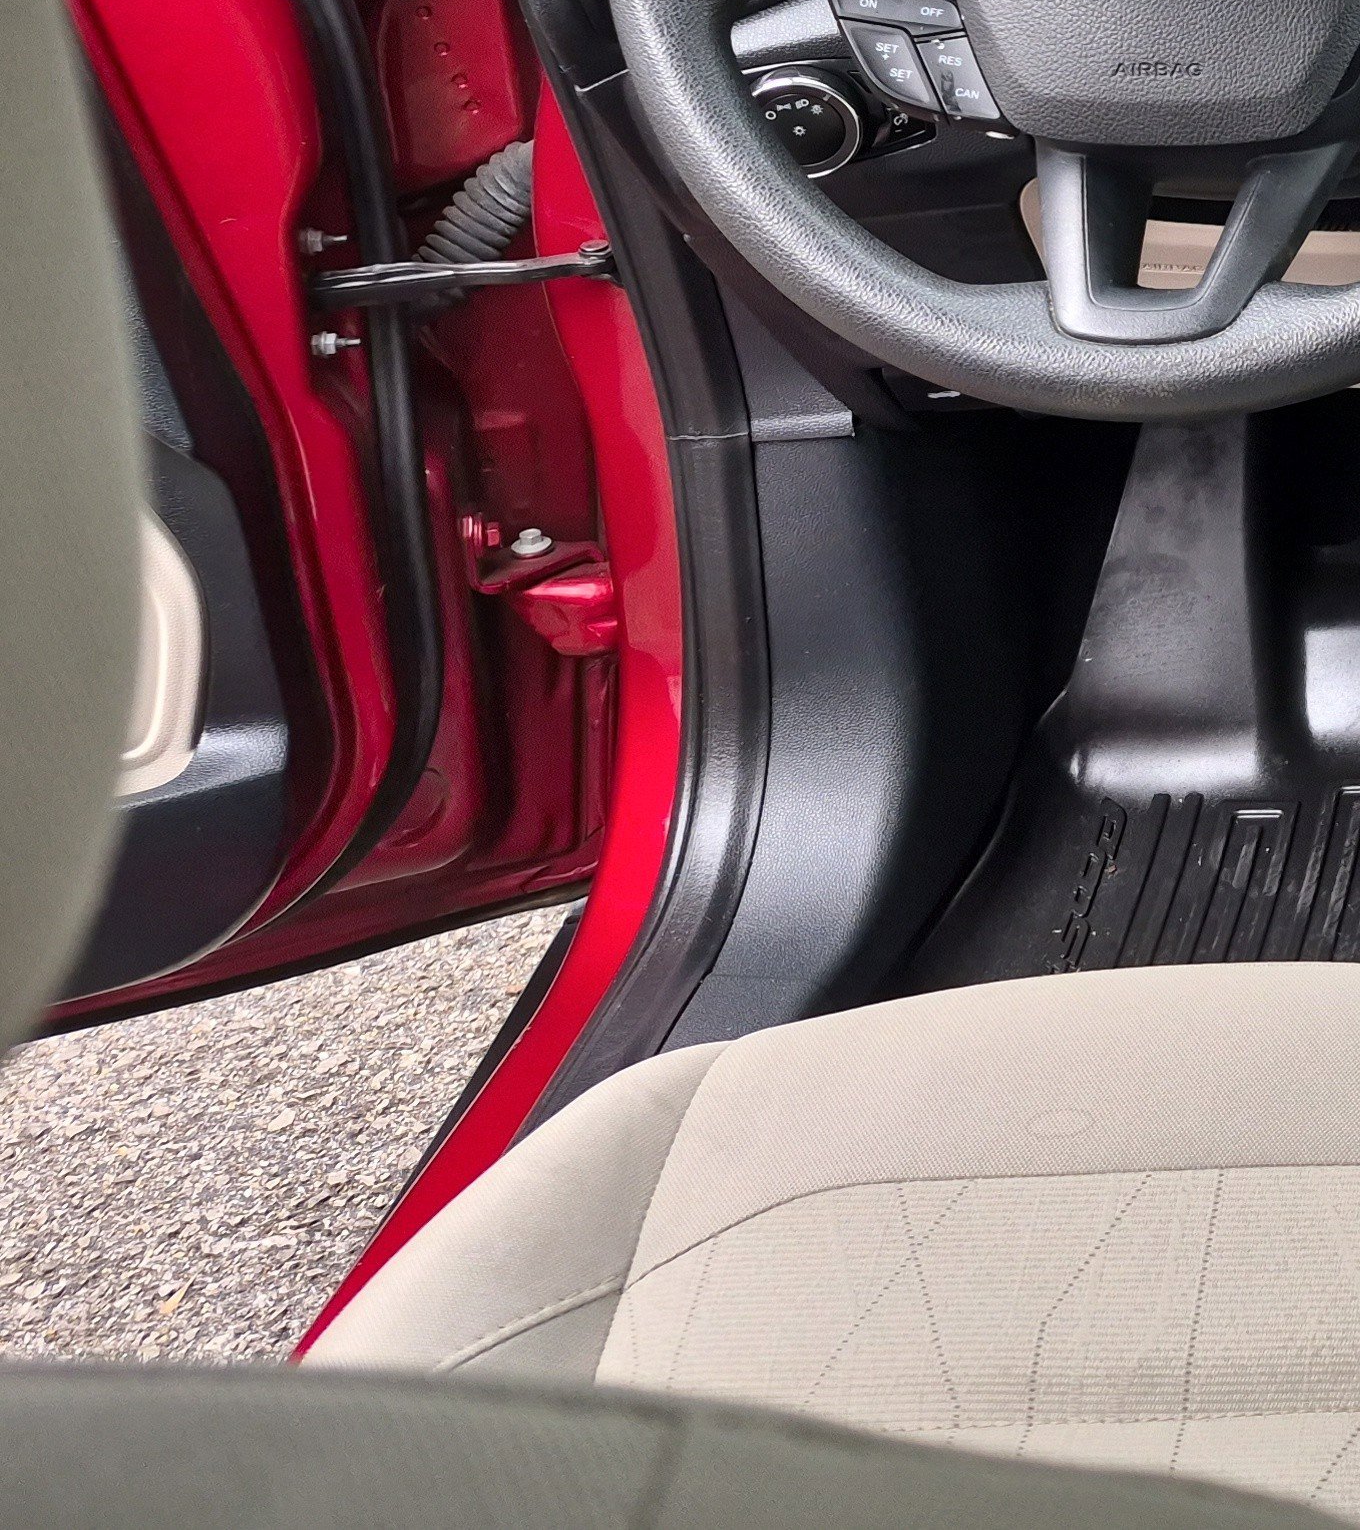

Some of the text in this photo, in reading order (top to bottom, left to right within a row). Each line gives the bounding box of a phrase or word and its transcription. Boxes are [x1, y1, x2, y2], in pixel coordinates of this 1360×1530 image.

[920, 6, 944, 18] OFF
[875, 42, 899, 54] SET
[938, 55, 963, 67] RES
[889, 68, 913, 79] SET
[1110, 61, 1203, 77] AIRBAG
[955, 88, 980, 100] CAN
